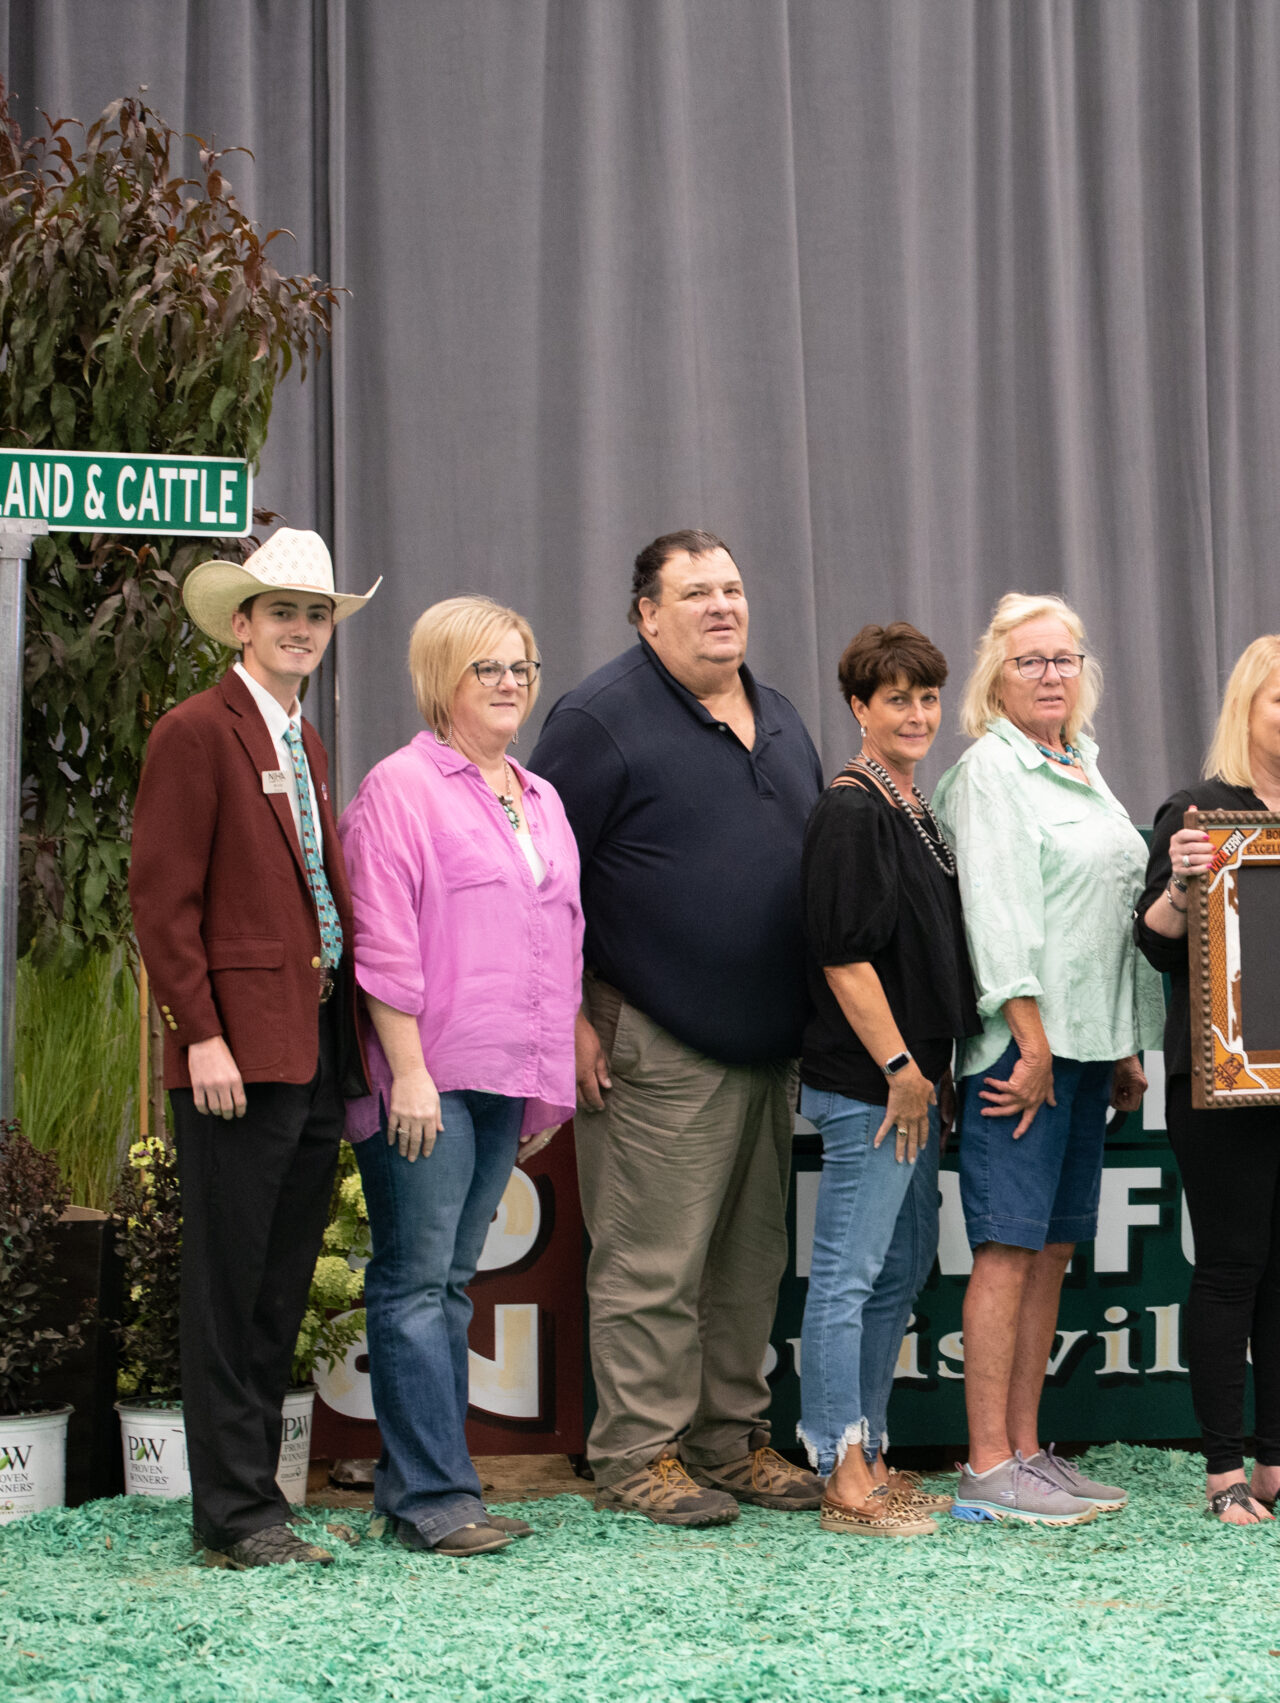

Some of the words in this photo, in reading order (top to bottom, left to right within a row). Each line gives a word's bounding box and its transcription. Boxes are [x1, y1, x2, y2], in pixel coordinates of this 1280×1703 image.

[0, 462, 74, 518] AND
[84, 464, 106, 520] &
[117, 465, 238, 524] CATTLE
[128, 1435, 167, 1462] PW
[131, 1464, 163, 1474] PROVEN
